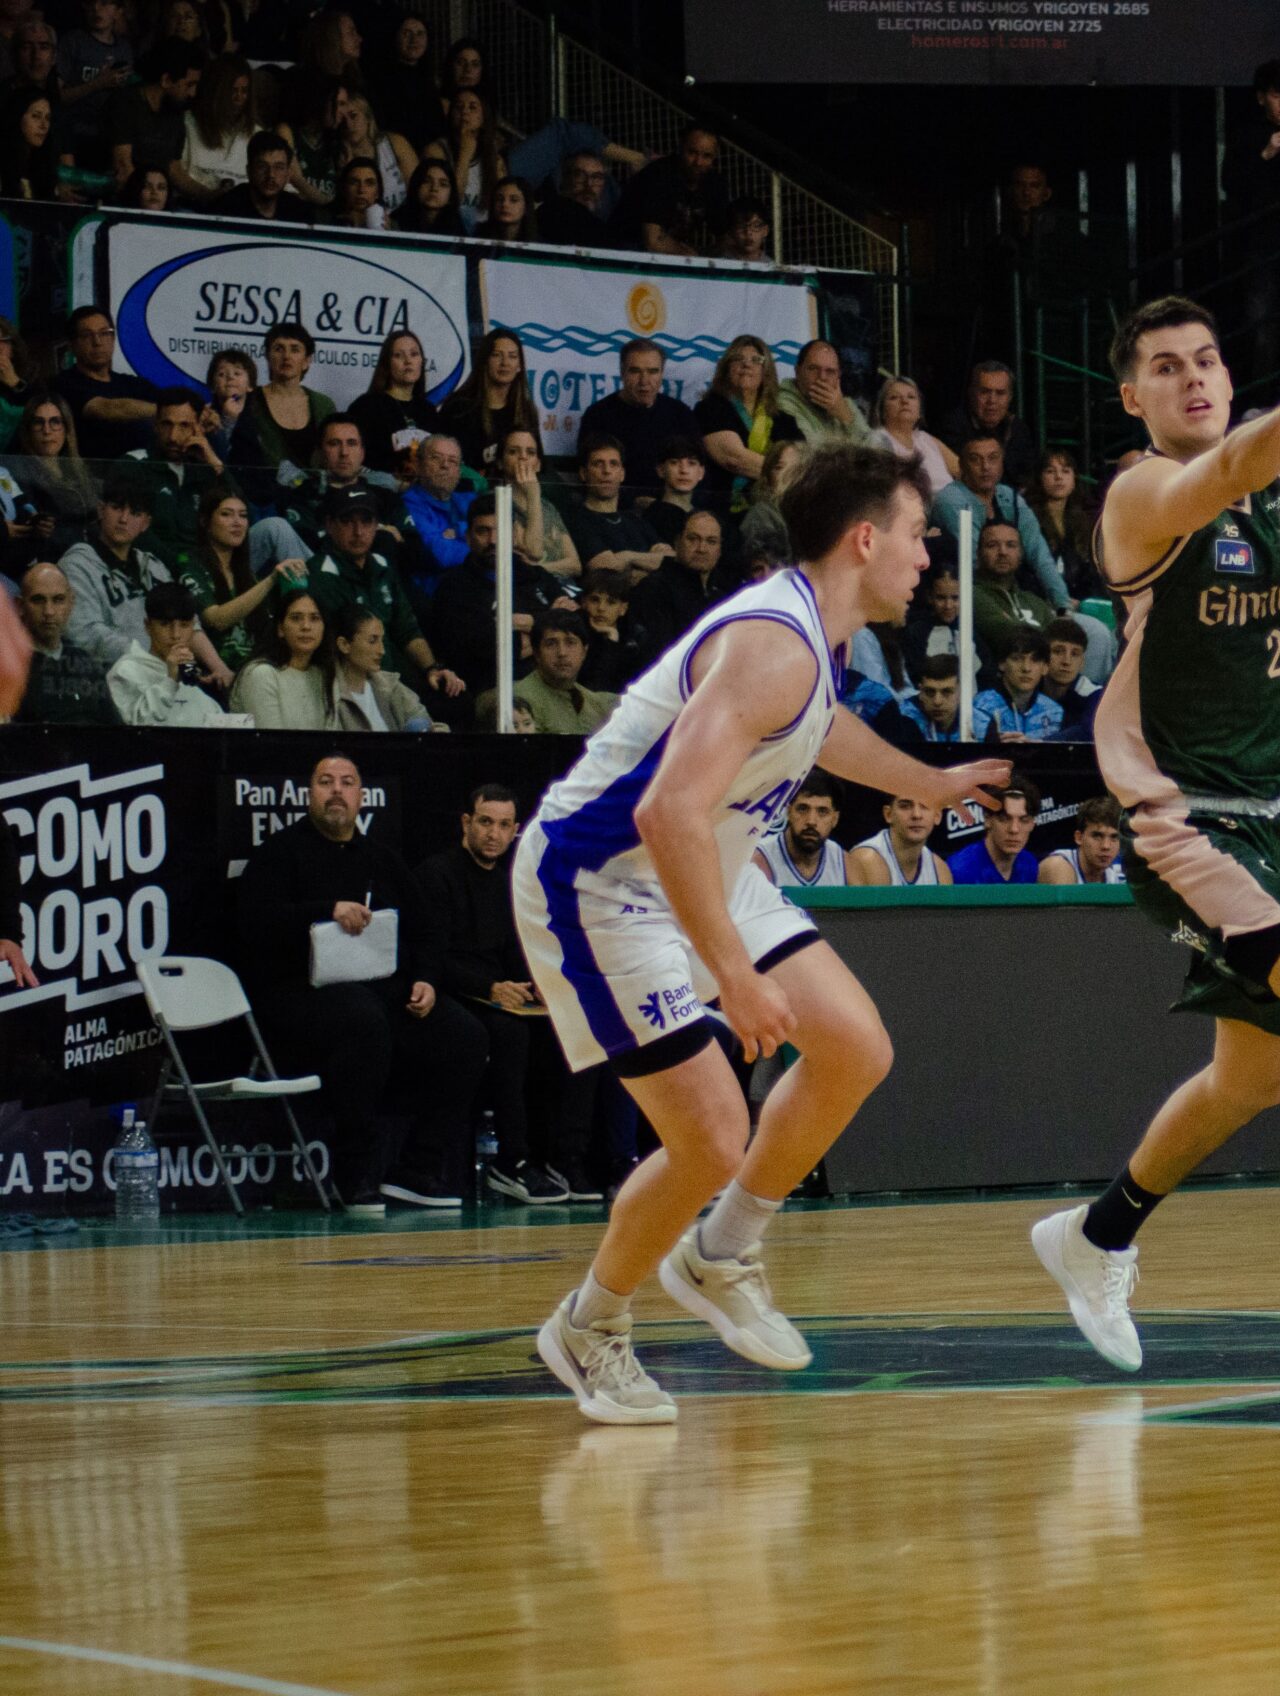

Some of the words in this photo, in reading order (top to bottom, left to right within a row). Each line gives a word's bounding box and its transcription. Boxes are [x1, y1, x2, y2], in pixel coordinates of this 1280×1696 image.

[1033, 2, 1109, 15] YRIGOYEN
[1113, 4, 1150, 15] 2685
[877, 19, 982, 31] ELECTRICIDAD
[987, 20, 1064, 32] YRIGOYEN
[1068, 21, 1102, 32] 2725
[196, 281, 302, 327] SESSA
[316, 292, 343, 332] &
[354, 296, 410, 337] CIA
[1221, 553, 1246, 566] LNB
[235, 778, 276, 806] Pan
[64, 1016, 108, 1046] ALMA
[42, 1149, 94, 1194] ES
